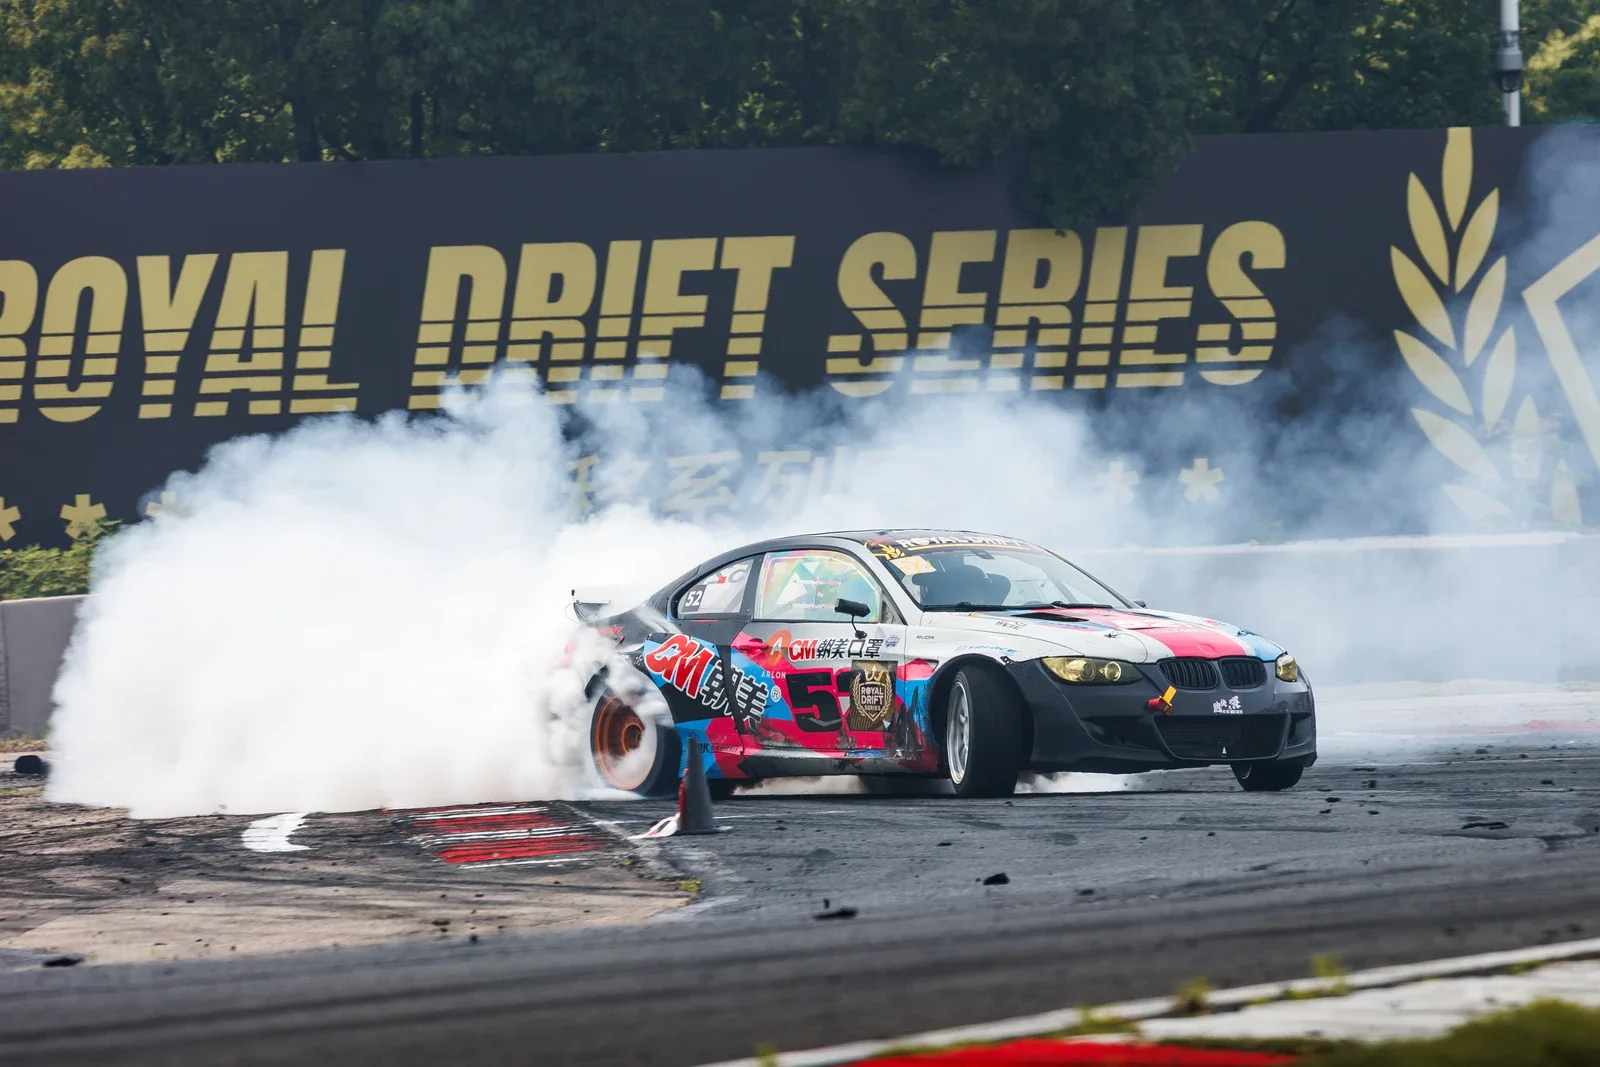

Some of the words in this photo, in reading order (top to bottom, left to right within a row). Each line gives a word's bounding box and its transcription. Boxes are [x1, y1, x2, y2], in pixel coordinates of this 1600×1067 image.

[407, 235, 796, 410] DRIFT
[825, 219, 1287, 398] SERIES
[895, 536, 969, 549] ROYAL
[685, 591, 704, 607] 52
[788, 638, 819, 661] CM
[760, 670, 786, 680] ARLON
[860, 686, 884, 696] ROYAL
[860, 695, 884, 705] DRIFT
[864, 704, 881, 712] SERIES
